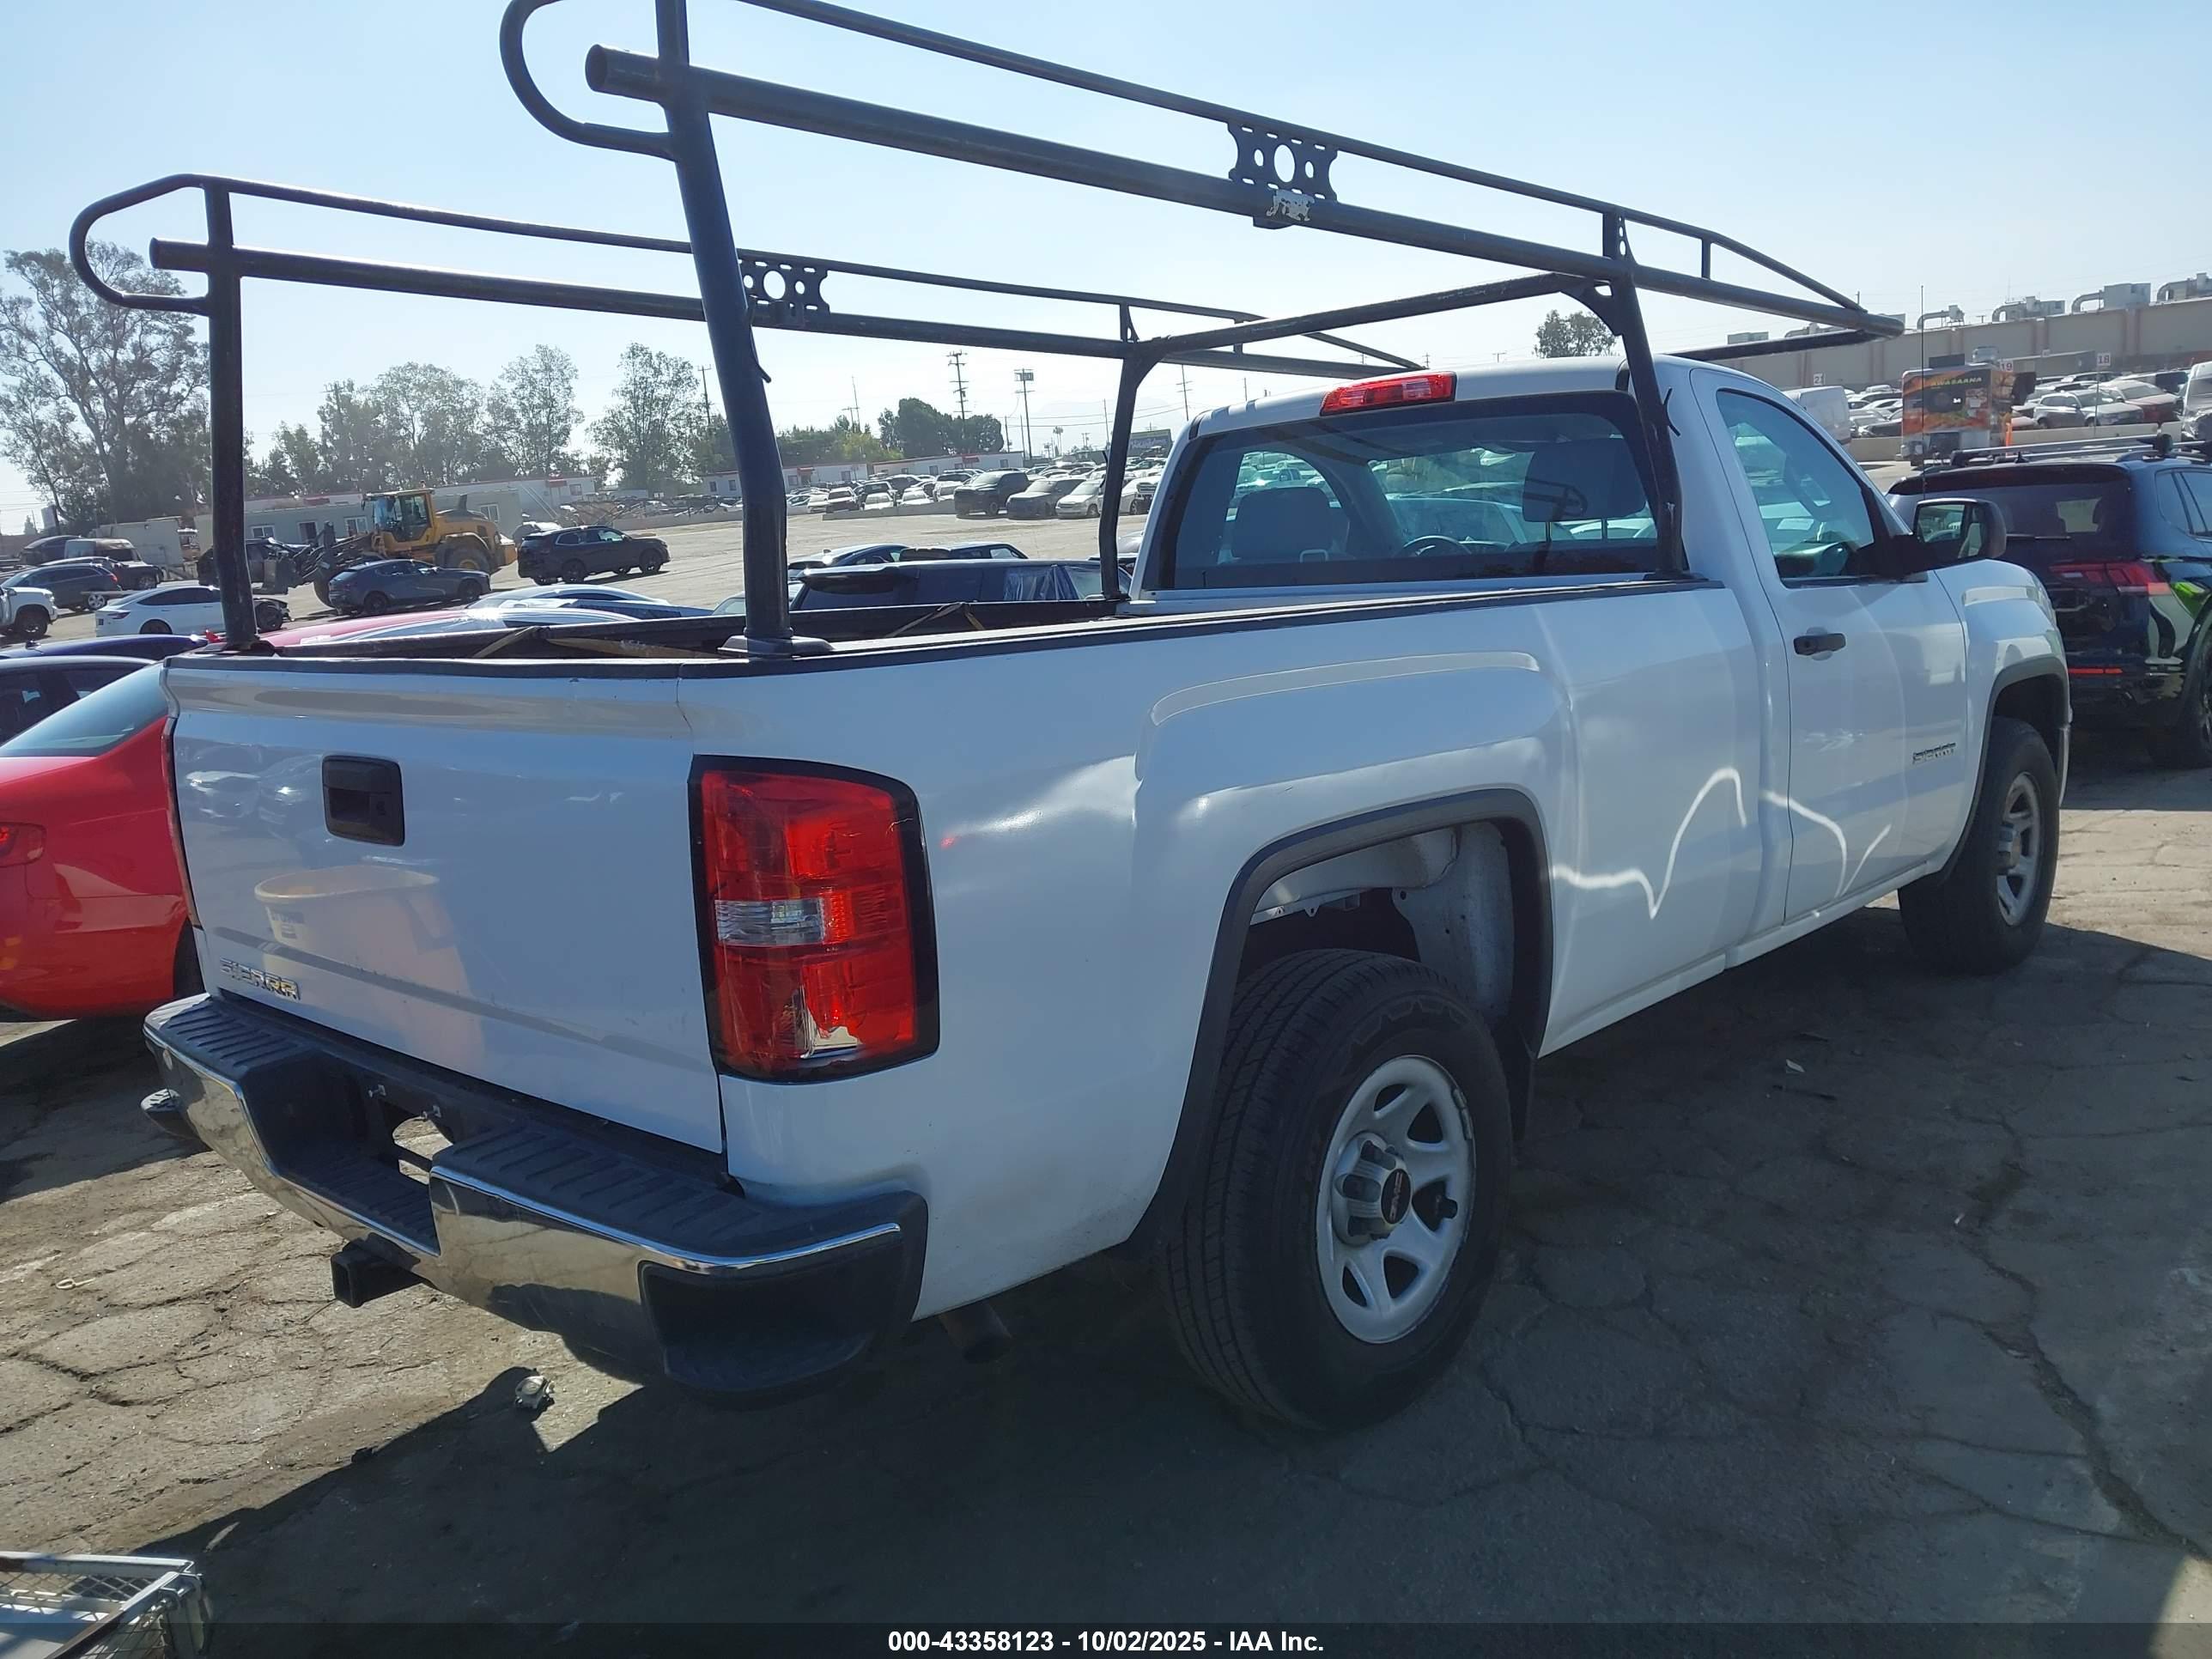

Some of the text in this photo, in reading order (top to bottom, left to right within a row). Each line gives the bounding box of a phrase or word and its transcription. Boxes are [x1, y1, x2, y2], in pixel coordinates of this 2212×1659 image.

[2099, 355, 2110, 364] 18
[2002, 362, 2013, 371] 19
[219, 957, 301, 1000] SIERRA
